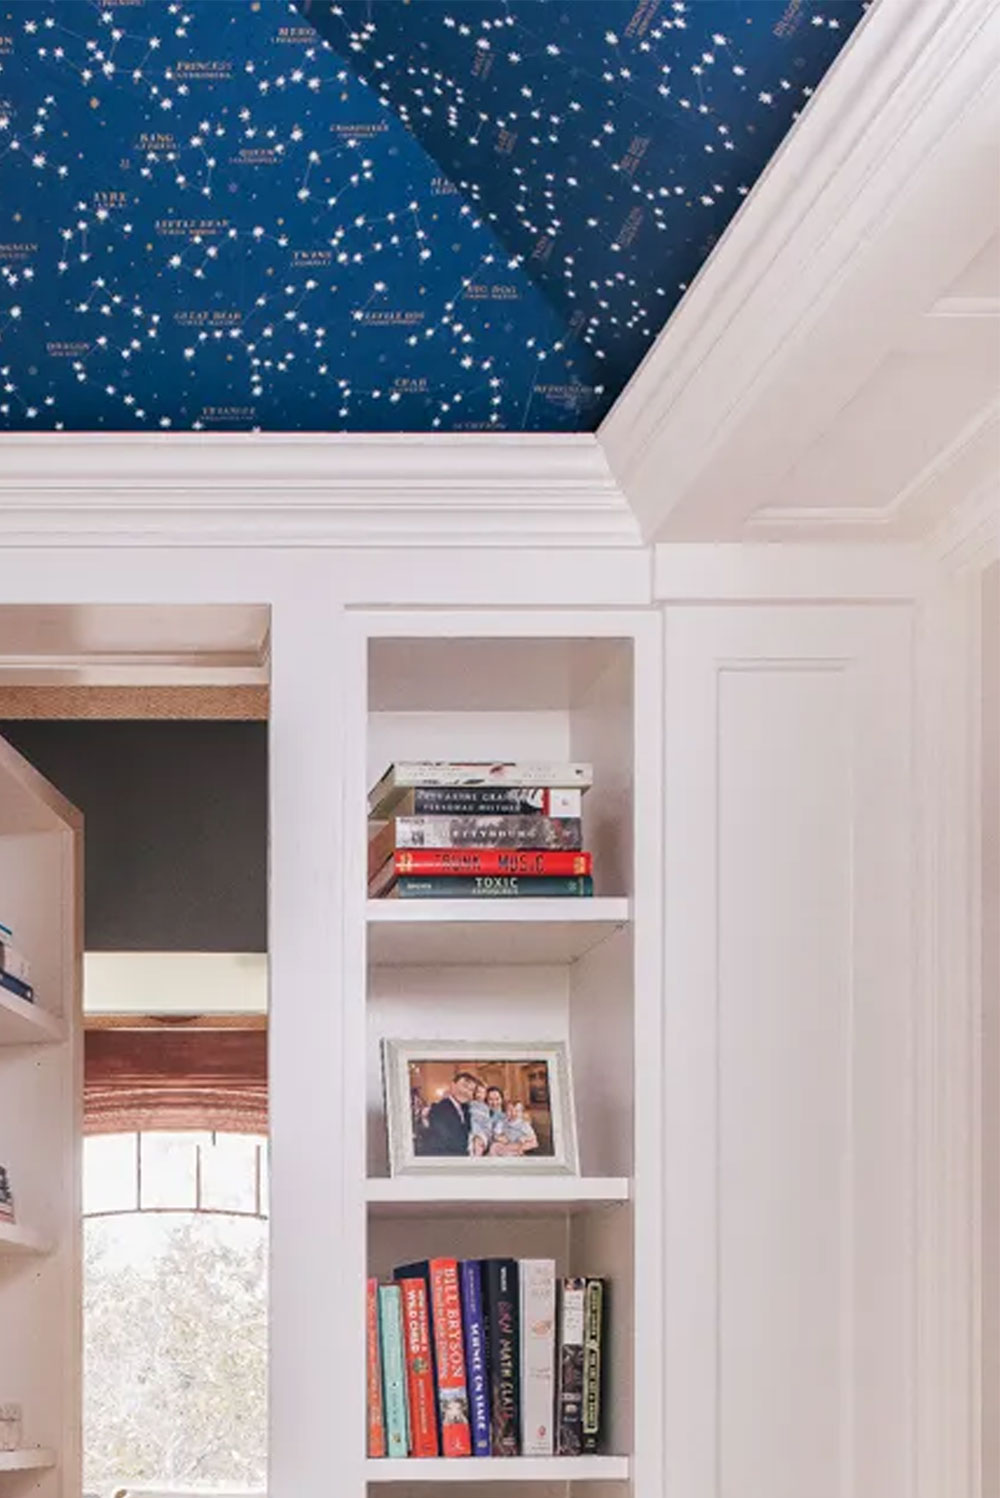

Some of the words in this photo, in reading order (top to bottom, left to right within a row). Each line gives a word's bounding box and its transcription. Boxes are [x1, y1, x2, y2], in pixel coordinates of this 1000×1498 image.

[474, 877, 518, 887] TOXIC
[444, 1268, 460, 1306] BILL
[407, 1290, 417, 1318] WILD
[409, 1320, 420, 1354] CHILD
[447, 1309, 463, 1378] BRYSON
[474, 1376, 484, 1392] ON
